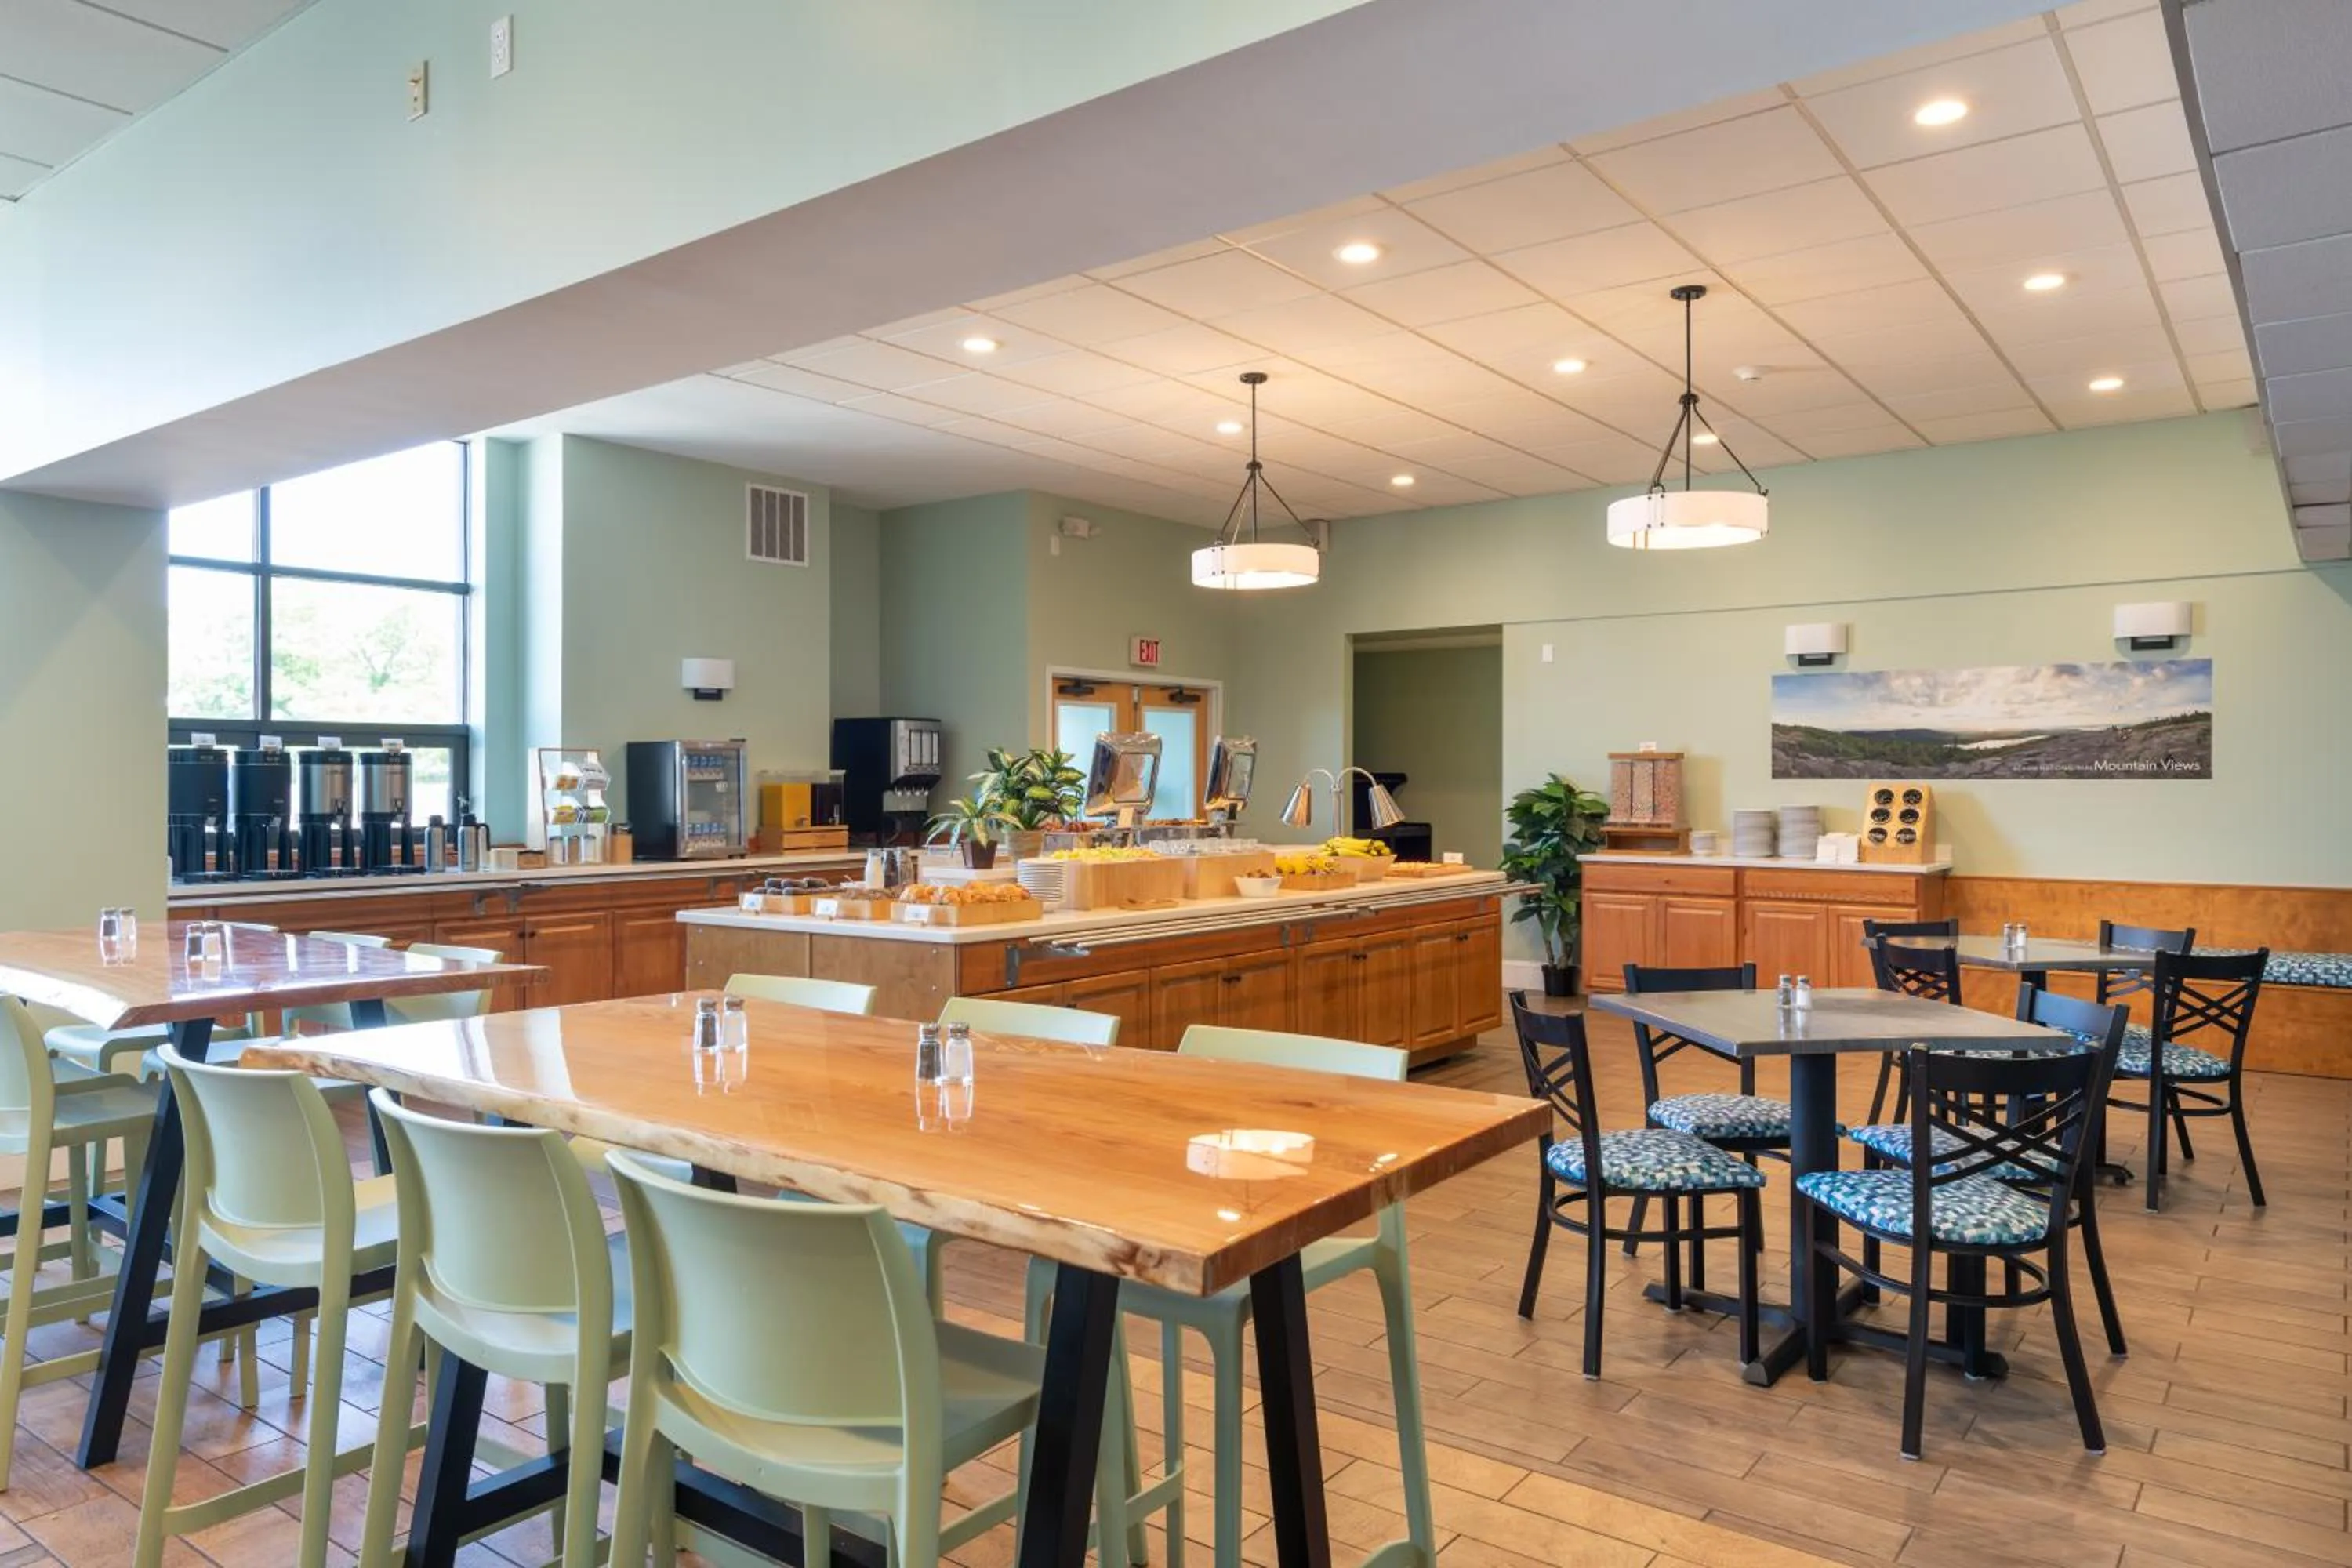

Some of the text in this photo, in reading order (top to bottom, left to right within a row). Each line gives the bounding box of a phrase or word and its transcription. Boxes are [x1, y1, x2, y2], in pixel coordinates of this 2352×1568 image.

[1139, 639, 1159, 664] EXIT
[2094, 760, 2156, 771] Mountain
[2160, 758, 2201, 771] Views
